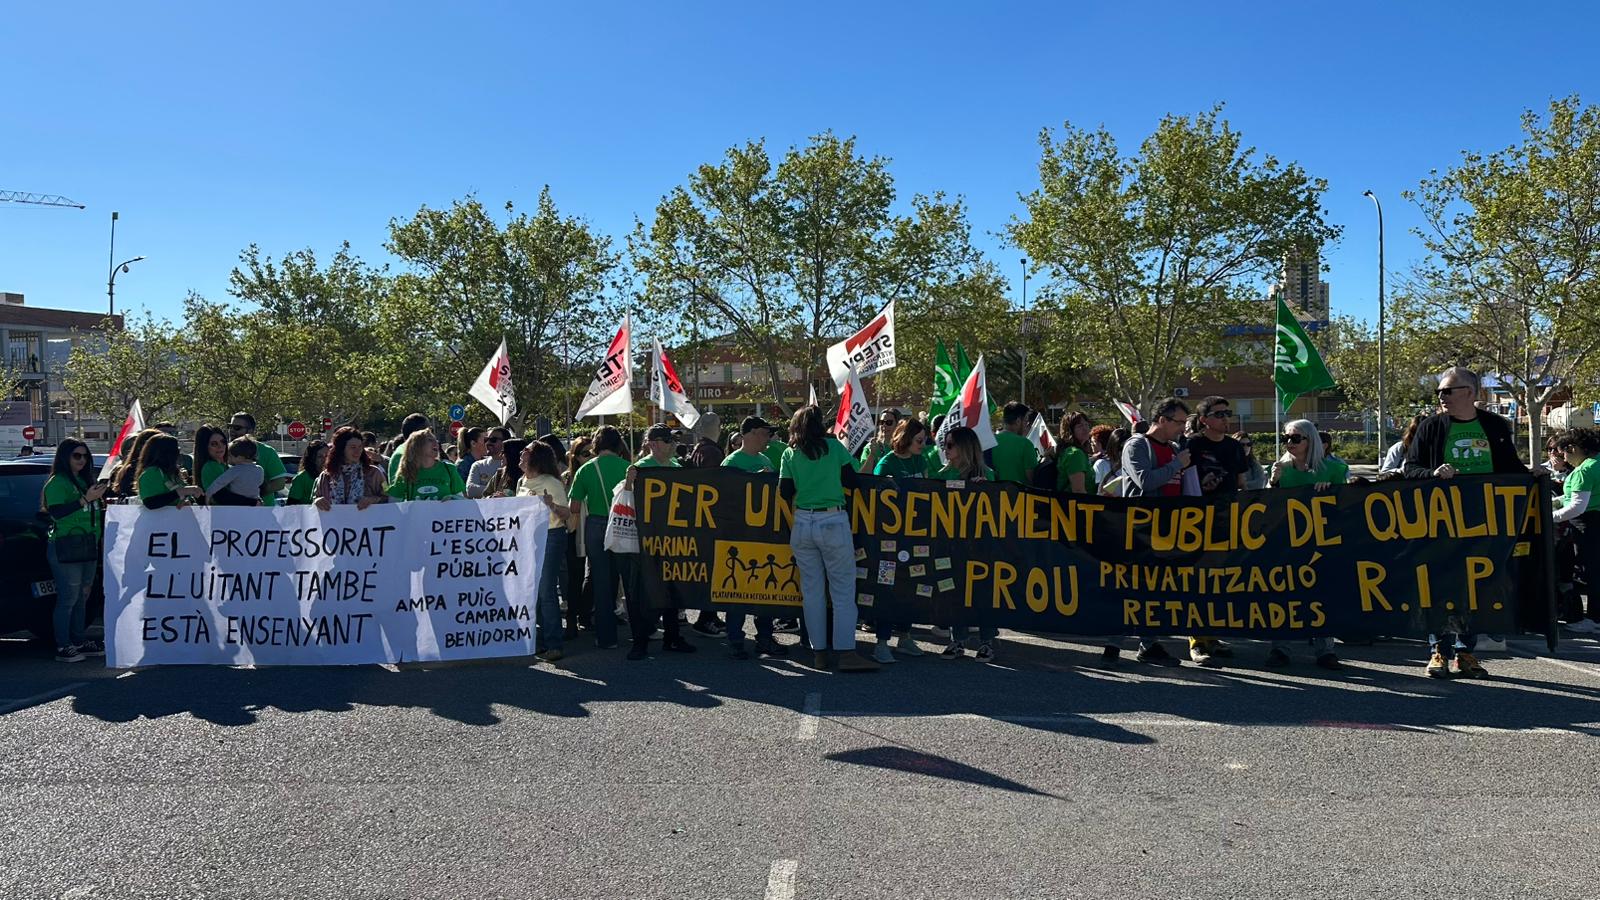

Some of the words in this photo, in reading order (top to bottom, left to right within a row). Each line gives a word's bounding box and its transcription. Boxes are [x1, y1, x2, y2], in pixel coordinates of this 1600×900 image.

[431, 516, 521, 533] DEFENSEM
[643, 478, 719, 529] PER
[845, 486, 1105, 545] NSENYAMENT
[1125, 502, 1267, 552] PUBLIC
[1287, 495, 1342, 547] DE
[1364, 483, 1542, 542] QUALITA
[147, 531, 191, 559] EL
[209, 525, 396, 559] PROFESSORAT
[430, 536, 519, 556] L'ESCOLA
[642, 536, 699, 557] MARINA
[295, 562, 378, 602] TAMBÉ
[662, 560, 709, 583] BAIXA
[1100, 551, 1323, 594] PRIVATITZACIÓ
[395, 594, 447, 612] AMPA
[964, 560, 1079, 616] PROU
[141, 609, 210, 644] ESTÀ
[226, 613, 374, 647] ENSENYANT
[455, 605, 531, 625] CAMPANA
[1123, 599, 1326, 629] RETALLADES
